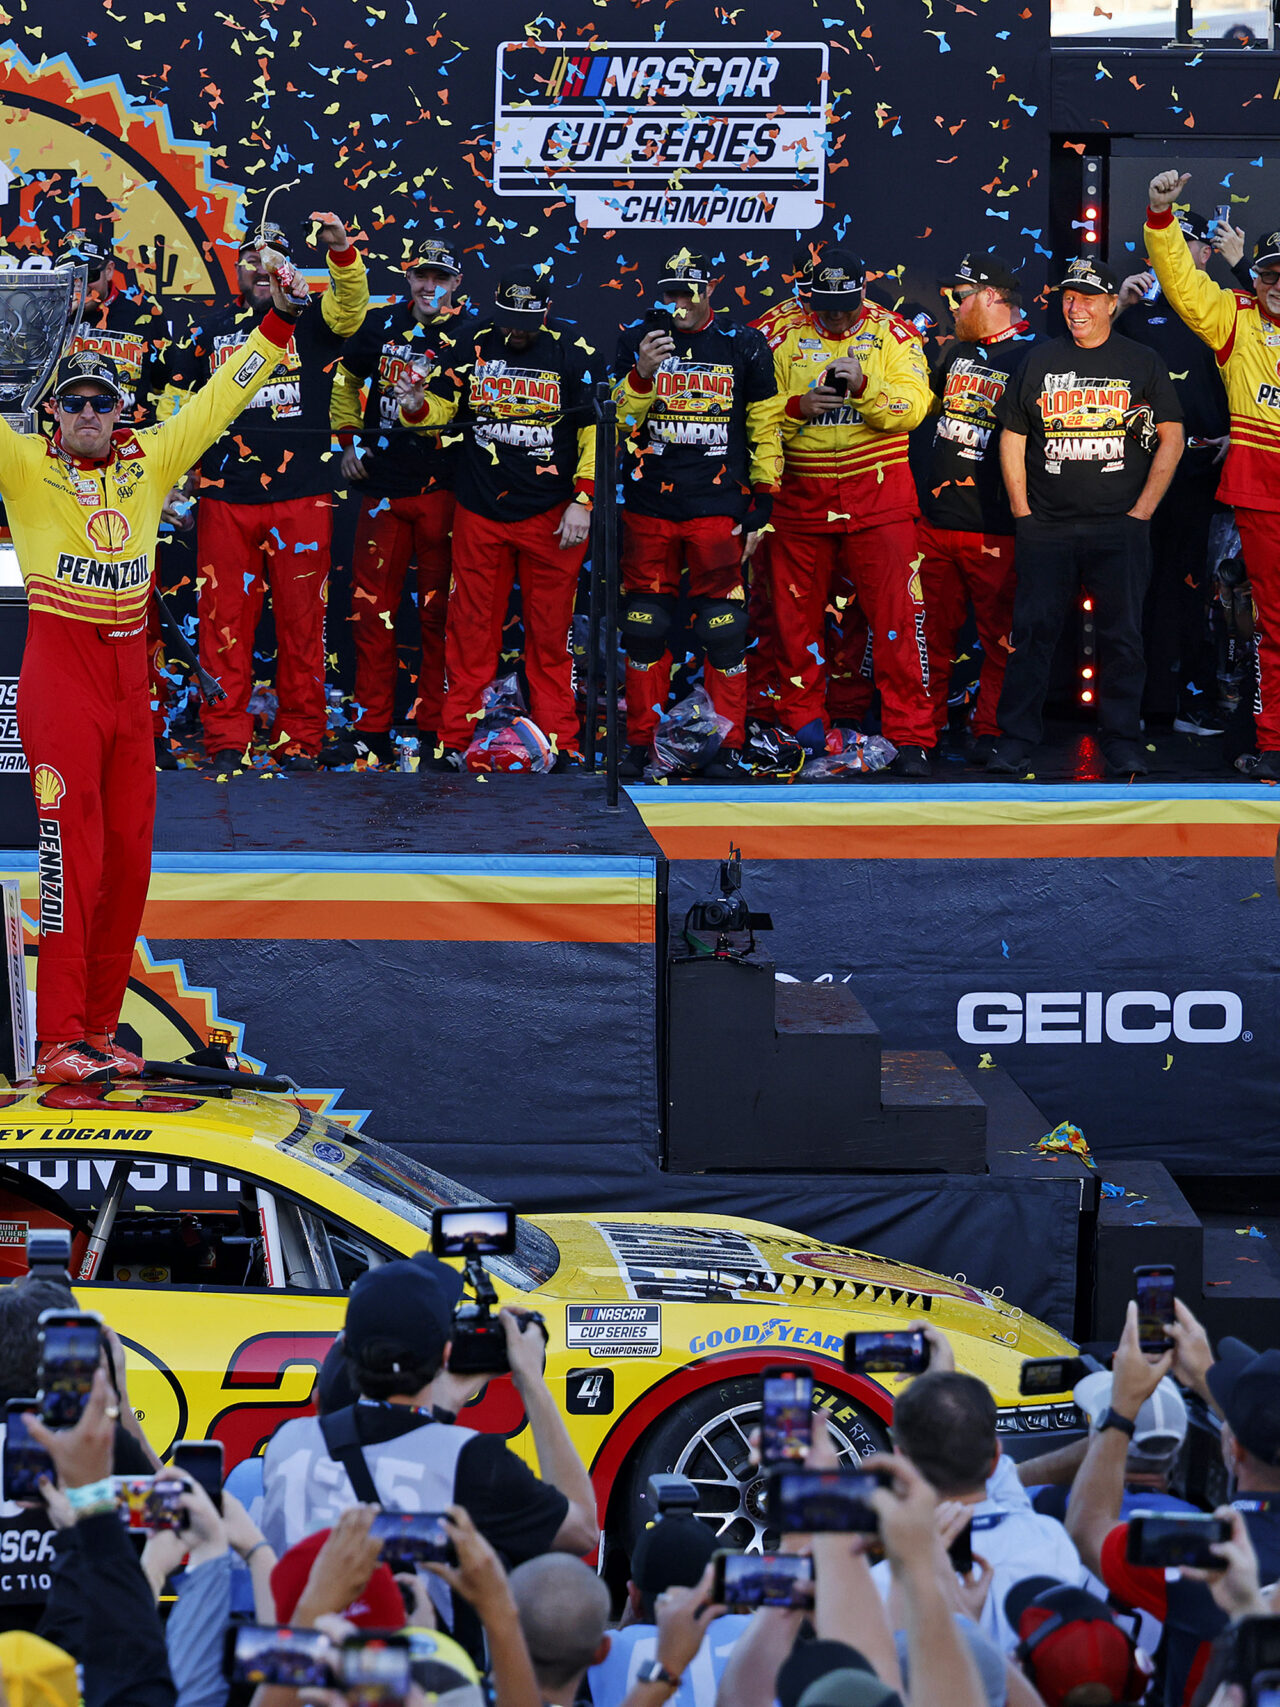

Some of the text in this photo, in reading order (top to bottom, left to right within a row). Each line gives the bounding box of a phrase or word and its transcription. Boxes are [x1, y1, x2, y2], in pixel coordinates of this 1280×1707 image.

[601, 56, 780, 97] NASCAR
[540, 123, 782, 162] CUP SERIES
[620, 196, 778, 223] CHAMPION
[122, 333, 144, 343] JOEY
[68, 350, 108, 368] Champion
[712, 366, 734, 374] JOEY
[538, 372, 561, 382] JOEY
[656, 372, 734, 397] OGANO
[989, 372, 1009, 381] JOEY
[1107, 380, 1131, 388] JOEY
[470, 376, 561, 405] LOGANO
[1256, 383, 1280, 408] PE
[669, 400, 687, 409] 22
[1041, 389, 1131, 419] LOGANO
[647, 420, 728, 445] CHAMPION
[1066, 415, 1083, 426] 22
[1044, 437, 1125, 461] CHAMPION
[55, 552, 149, 591] PENNZOIL
[108, 630, 130, 638] JOEY
[913, 611, 930, 690] ENNZOIL
[39, 818, 64, 937] PENNZOIL
[957, 991, 1242, 1044] GEICO
[40, 1129, 153, 1141] LOGANO
[597, 1308, 647, 1321] NASCAR
[580, 1326, 648, 1338] CUP SERIES
[593, 1346, 658, 1355] CHAMPIONSHIP
[576, 1375, 604, 1408] 4
[812, 1387, 858, 1425] GLE
